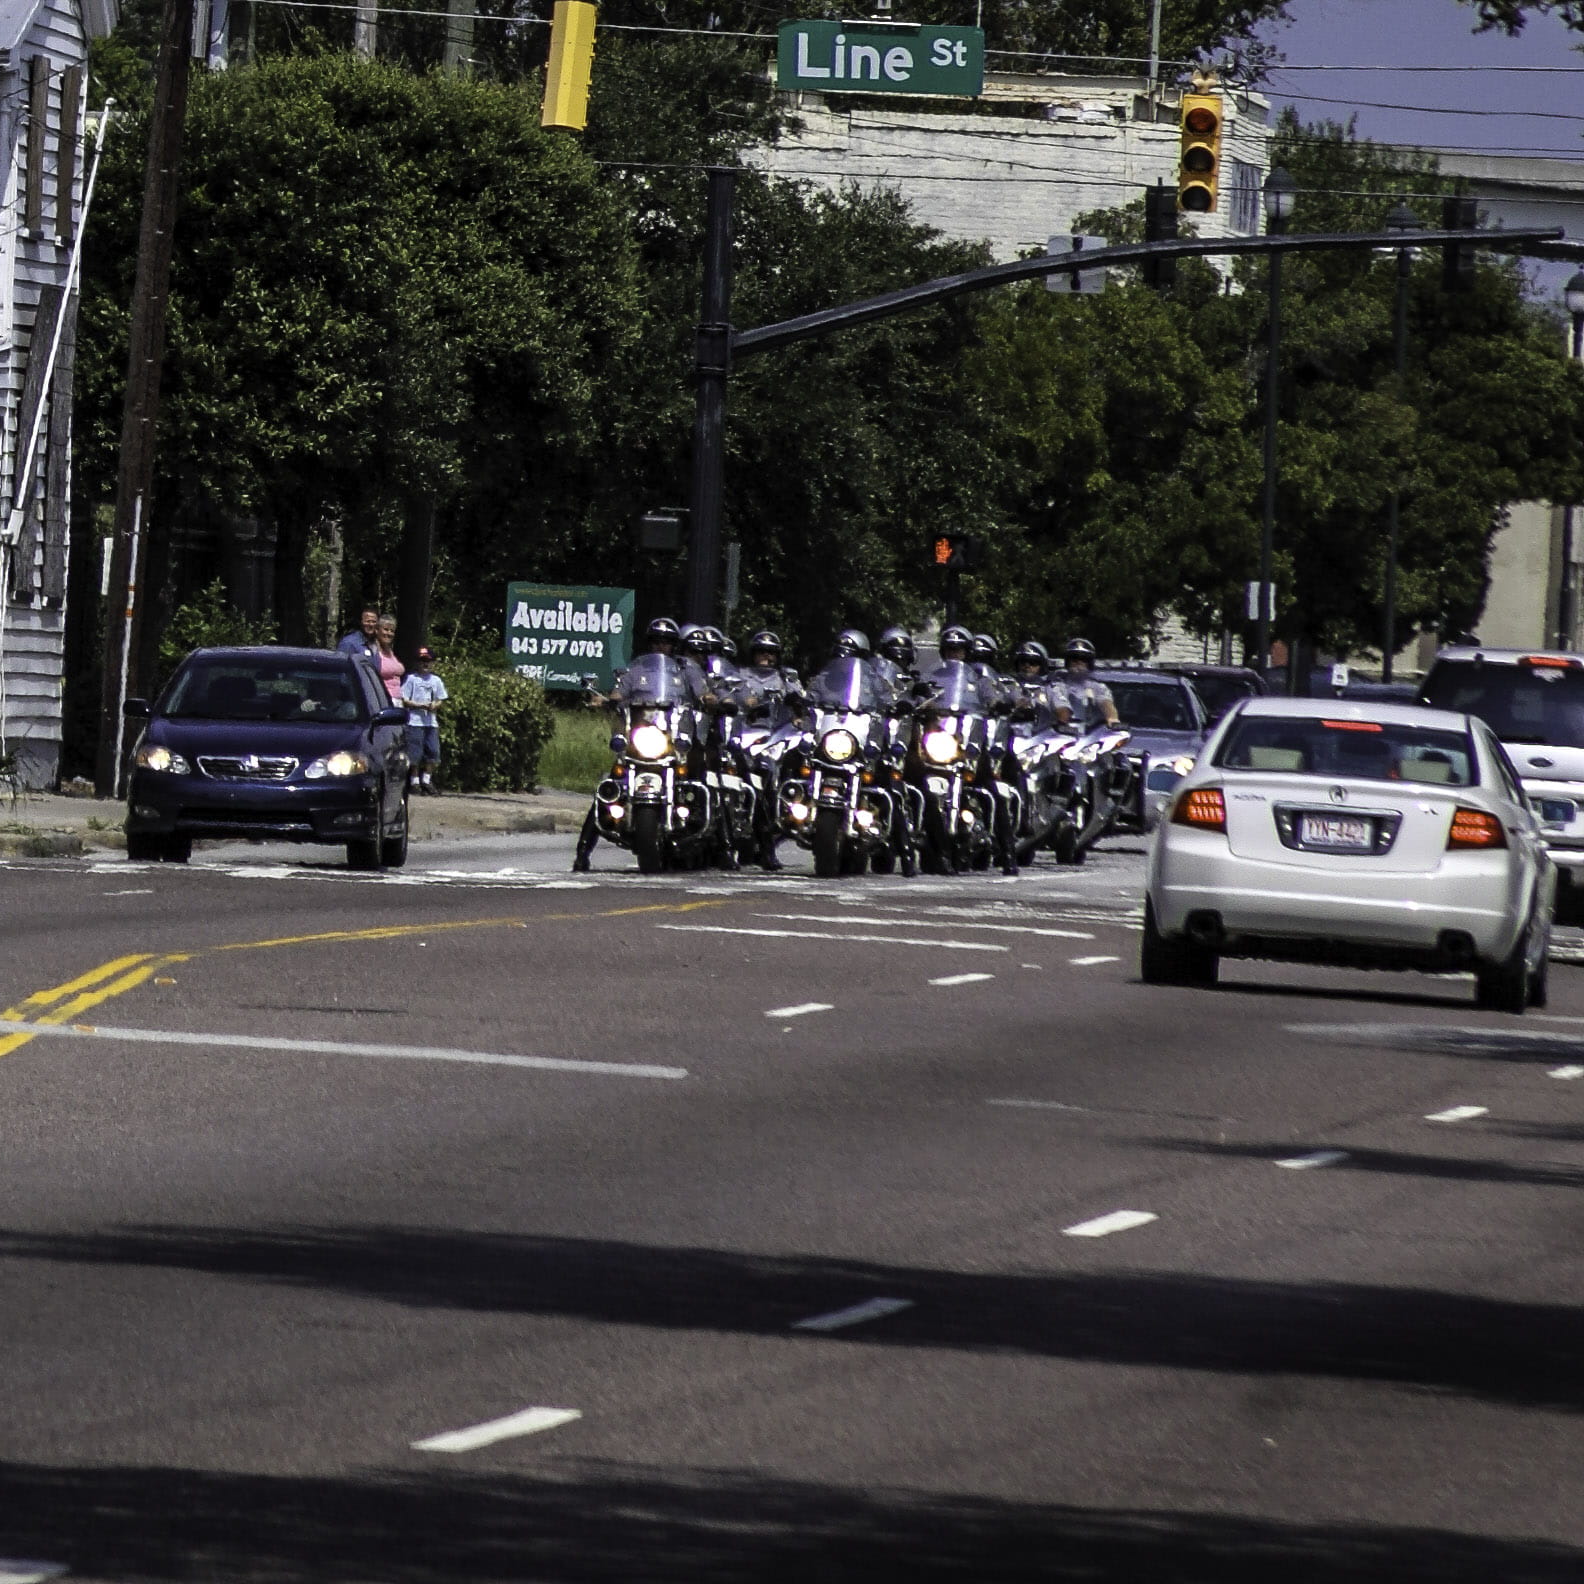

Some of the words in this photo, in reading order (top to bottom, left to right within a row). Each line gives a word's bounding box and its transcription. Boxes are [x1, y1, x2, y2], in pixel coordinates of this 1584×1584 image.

[797, 32, 914, 82] Line
[930, 38, 968, 67] St
[512, 600, 623, 634] Available
[541, 638, 568, 655] 577
[569, 640, 604, 658] 0702
